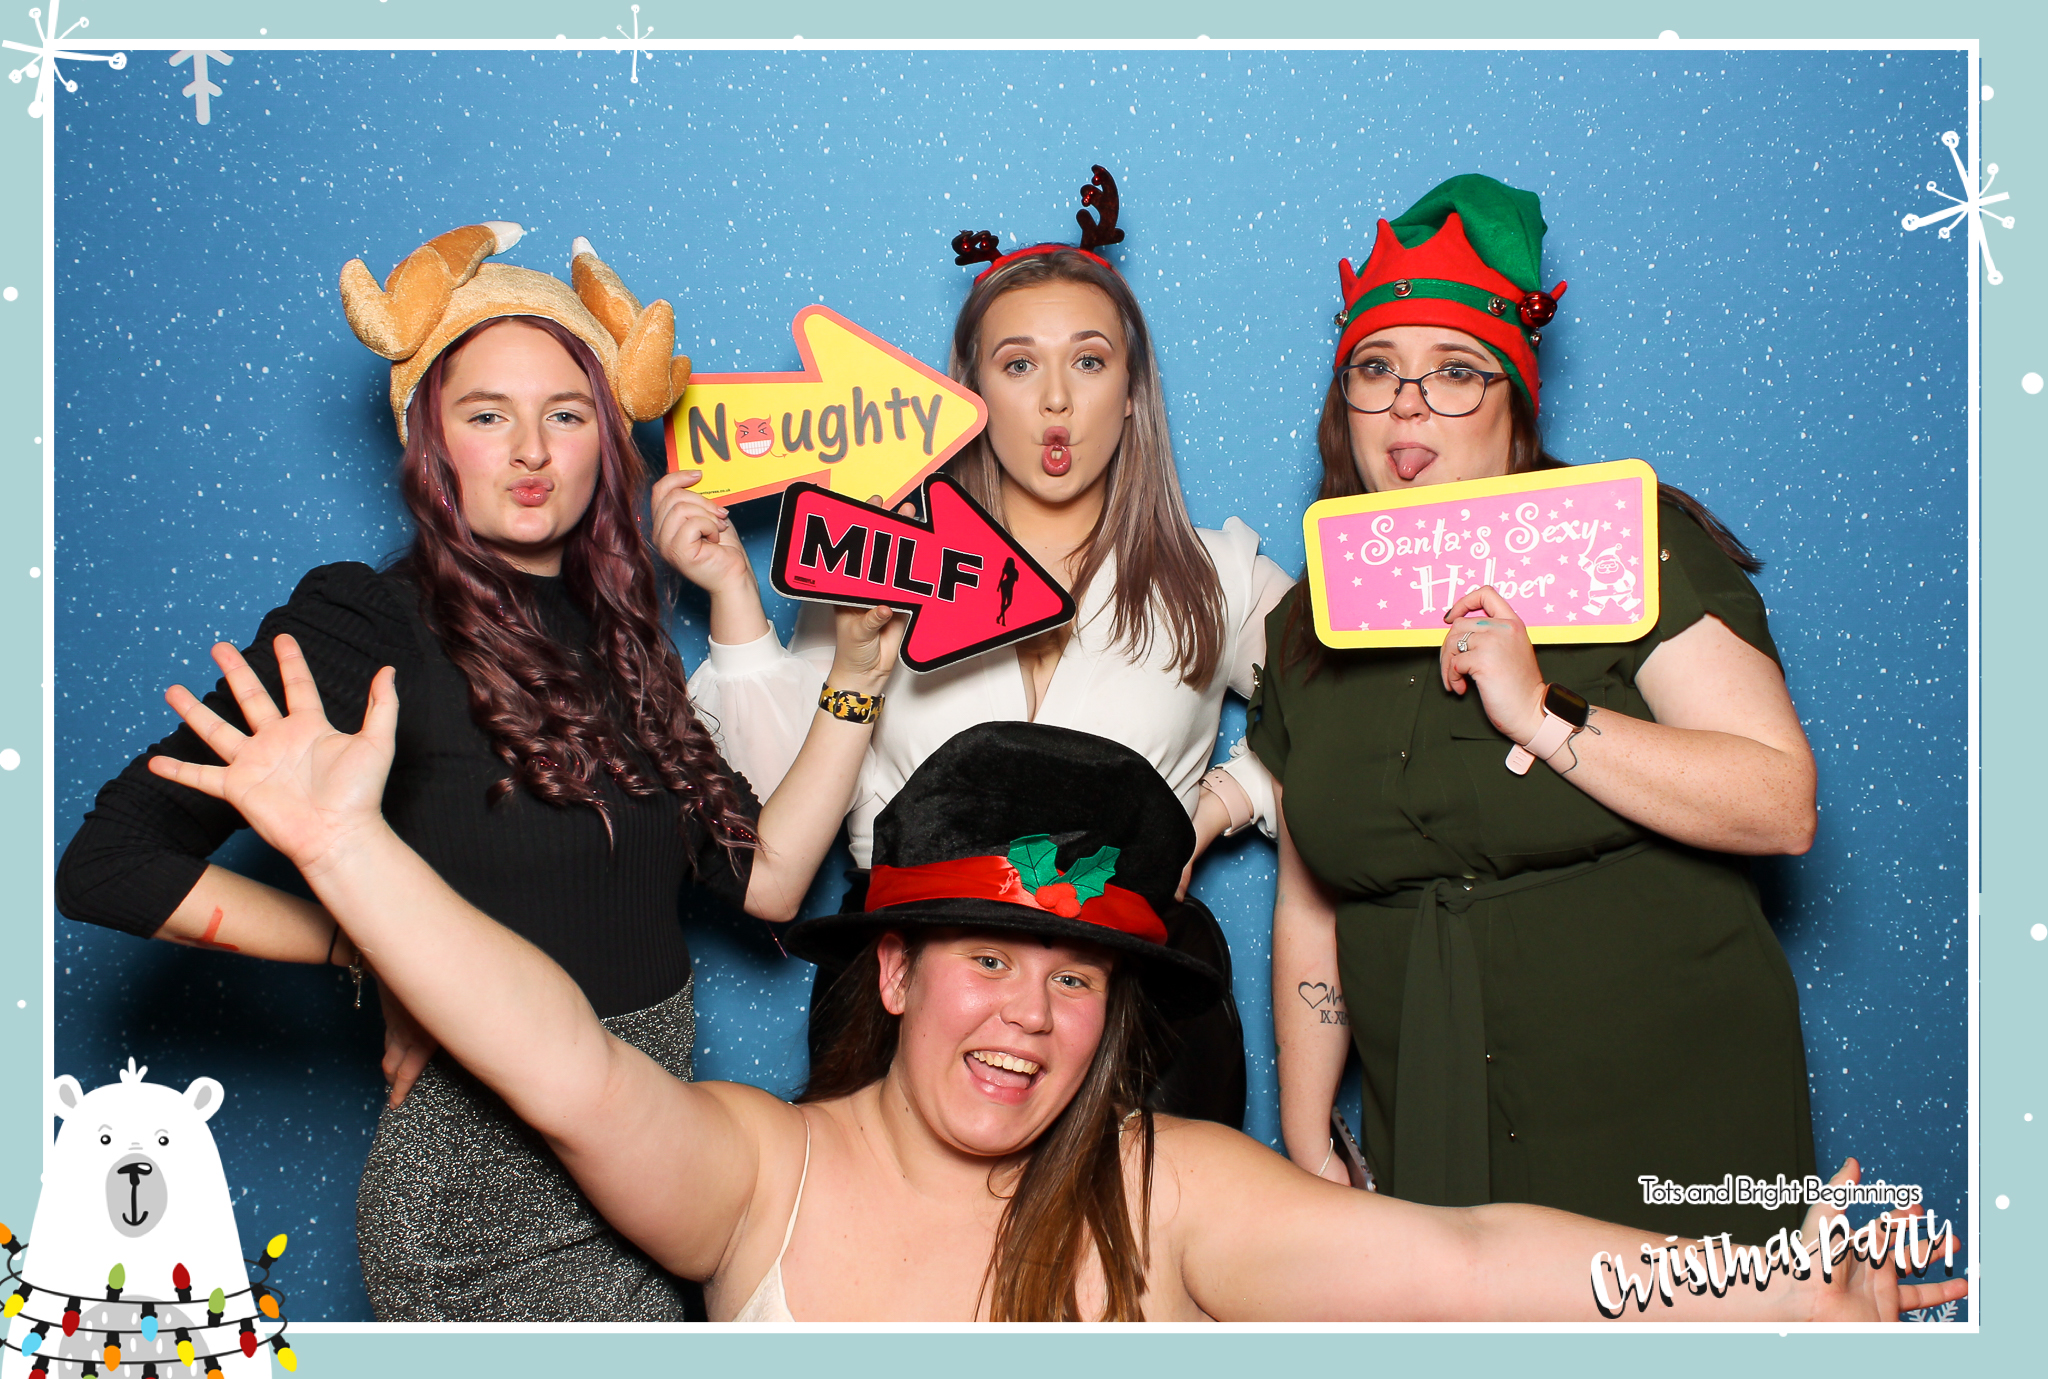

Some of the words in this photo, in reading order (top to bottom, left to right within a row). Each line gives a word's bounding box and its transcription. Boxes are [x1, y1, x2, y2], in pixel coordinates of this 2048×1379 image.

[798, 514, 985, 603] MILF
[1360, 508, 1492, 566] Santa's
[1504, 501, 1600, 555] Sexy
